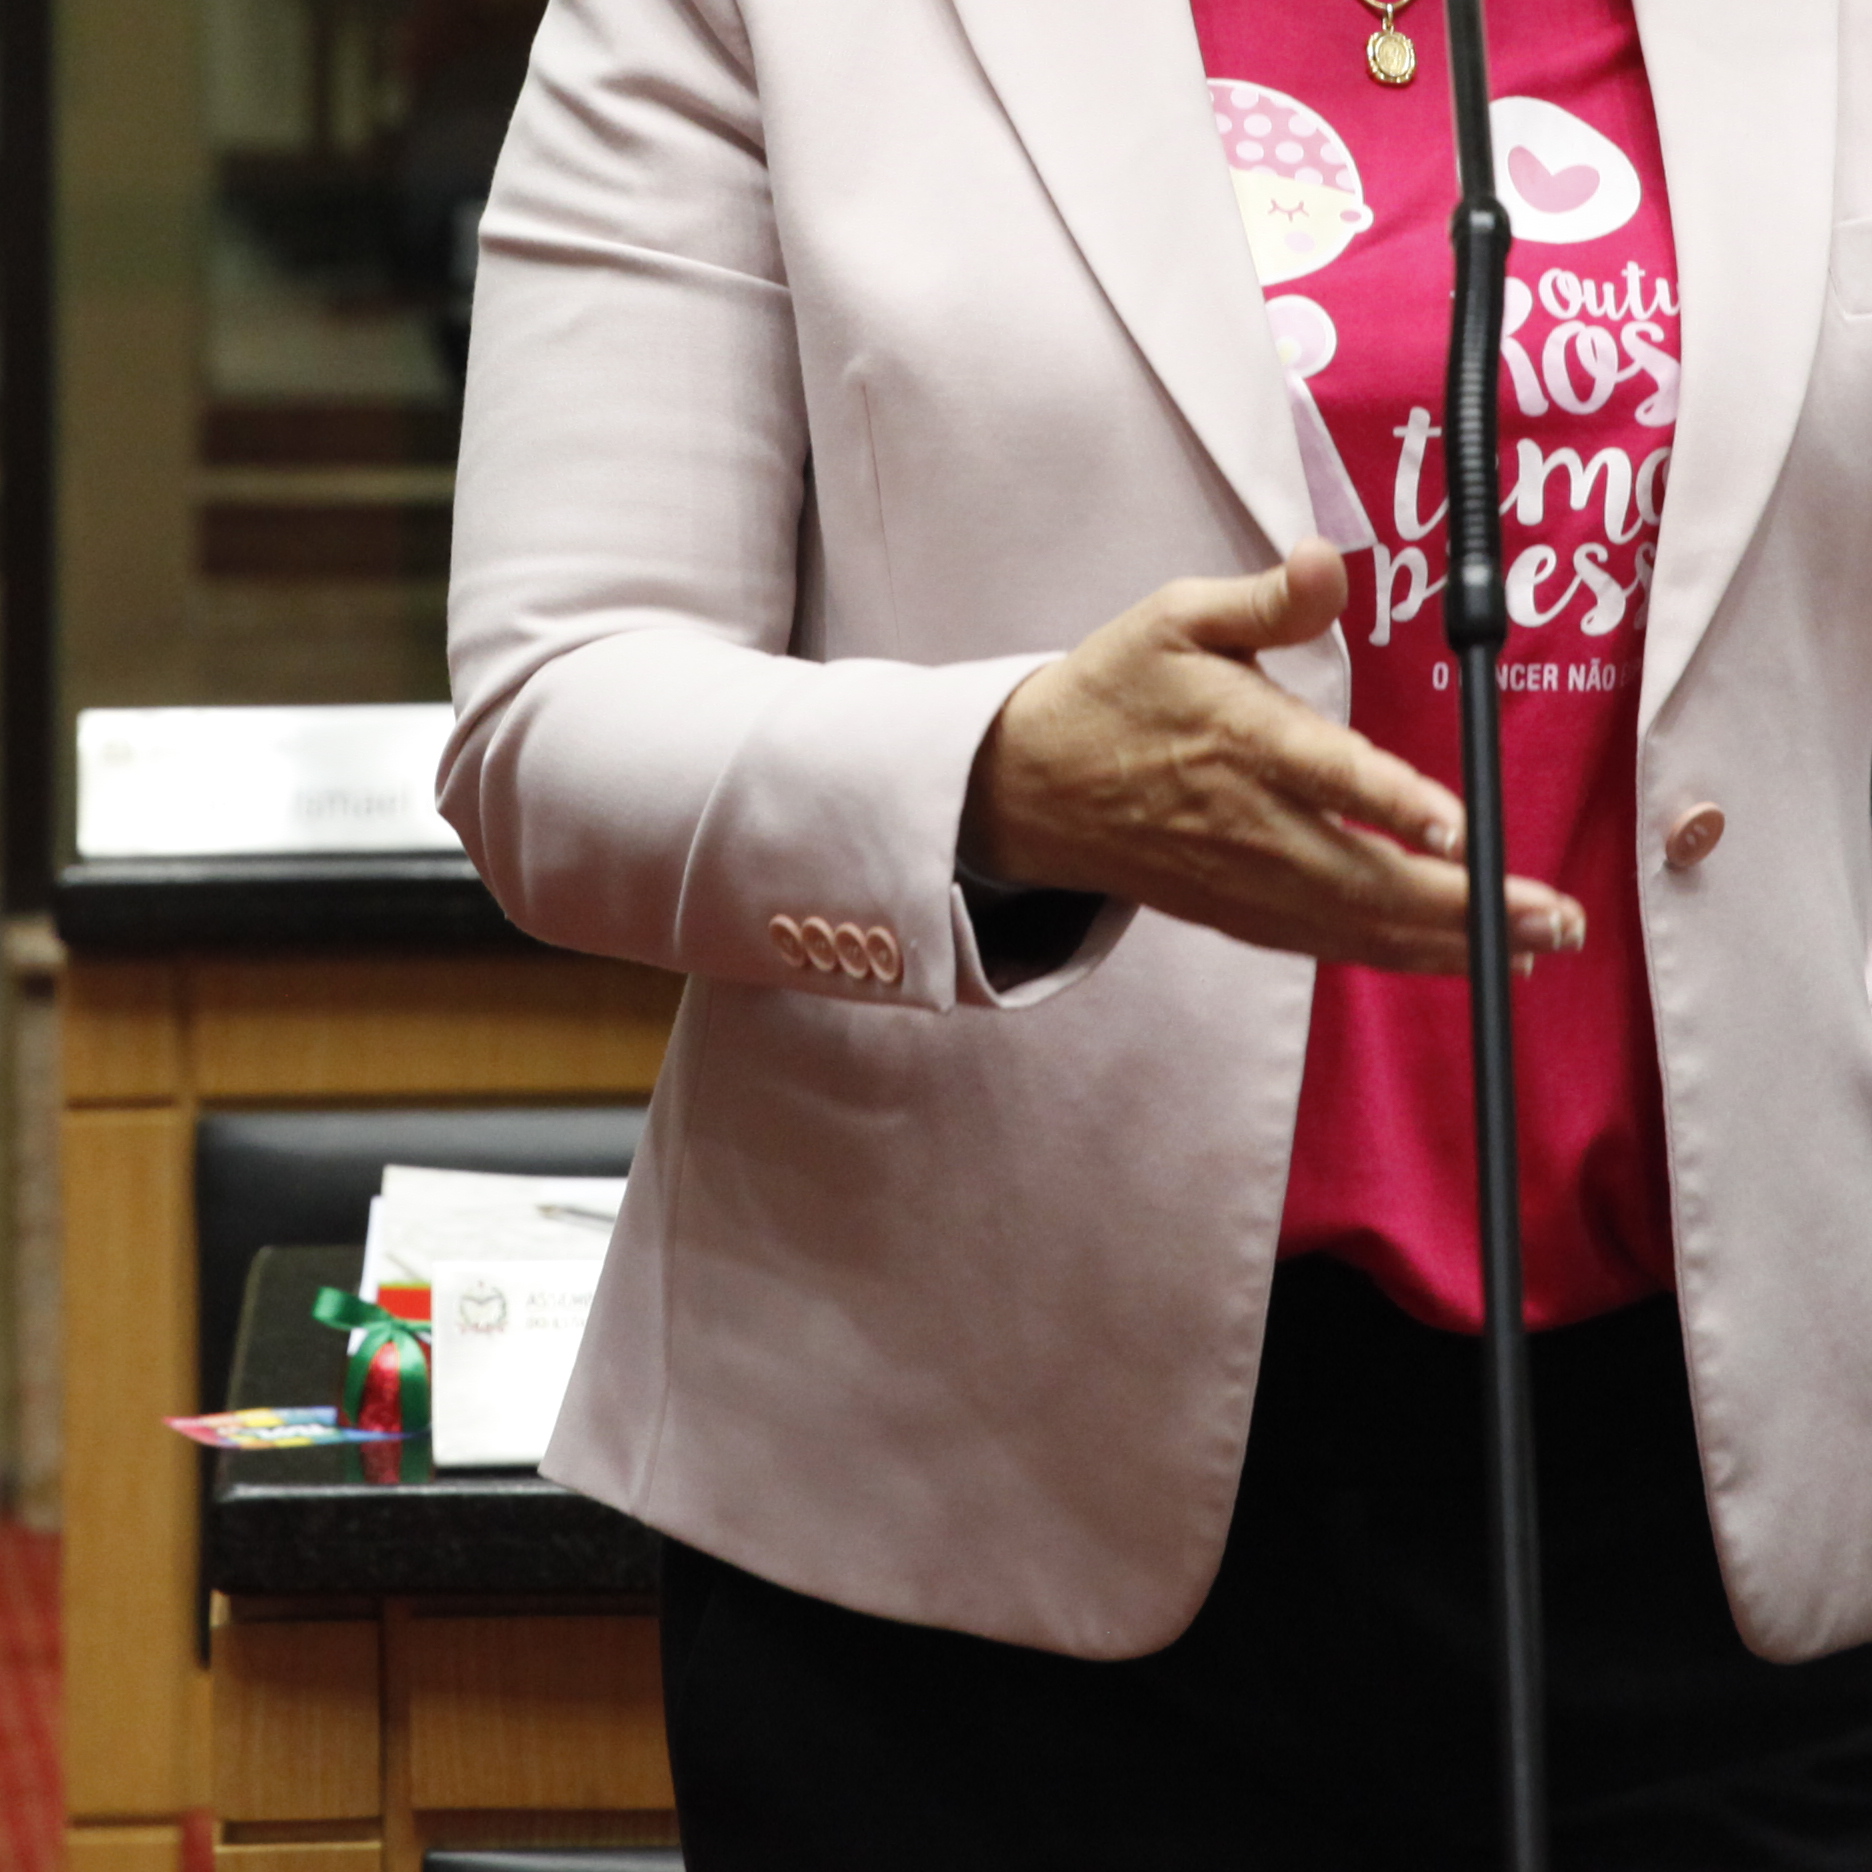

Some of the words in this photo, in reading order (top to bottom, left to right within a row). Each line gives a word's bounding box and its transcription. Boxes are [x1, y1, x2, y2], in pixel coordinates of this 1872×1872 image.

[1368, 539, 1657, 646] pess
[1432, 661, 1449, 691] O
[1567, 657, 1617, 692] NÃO
